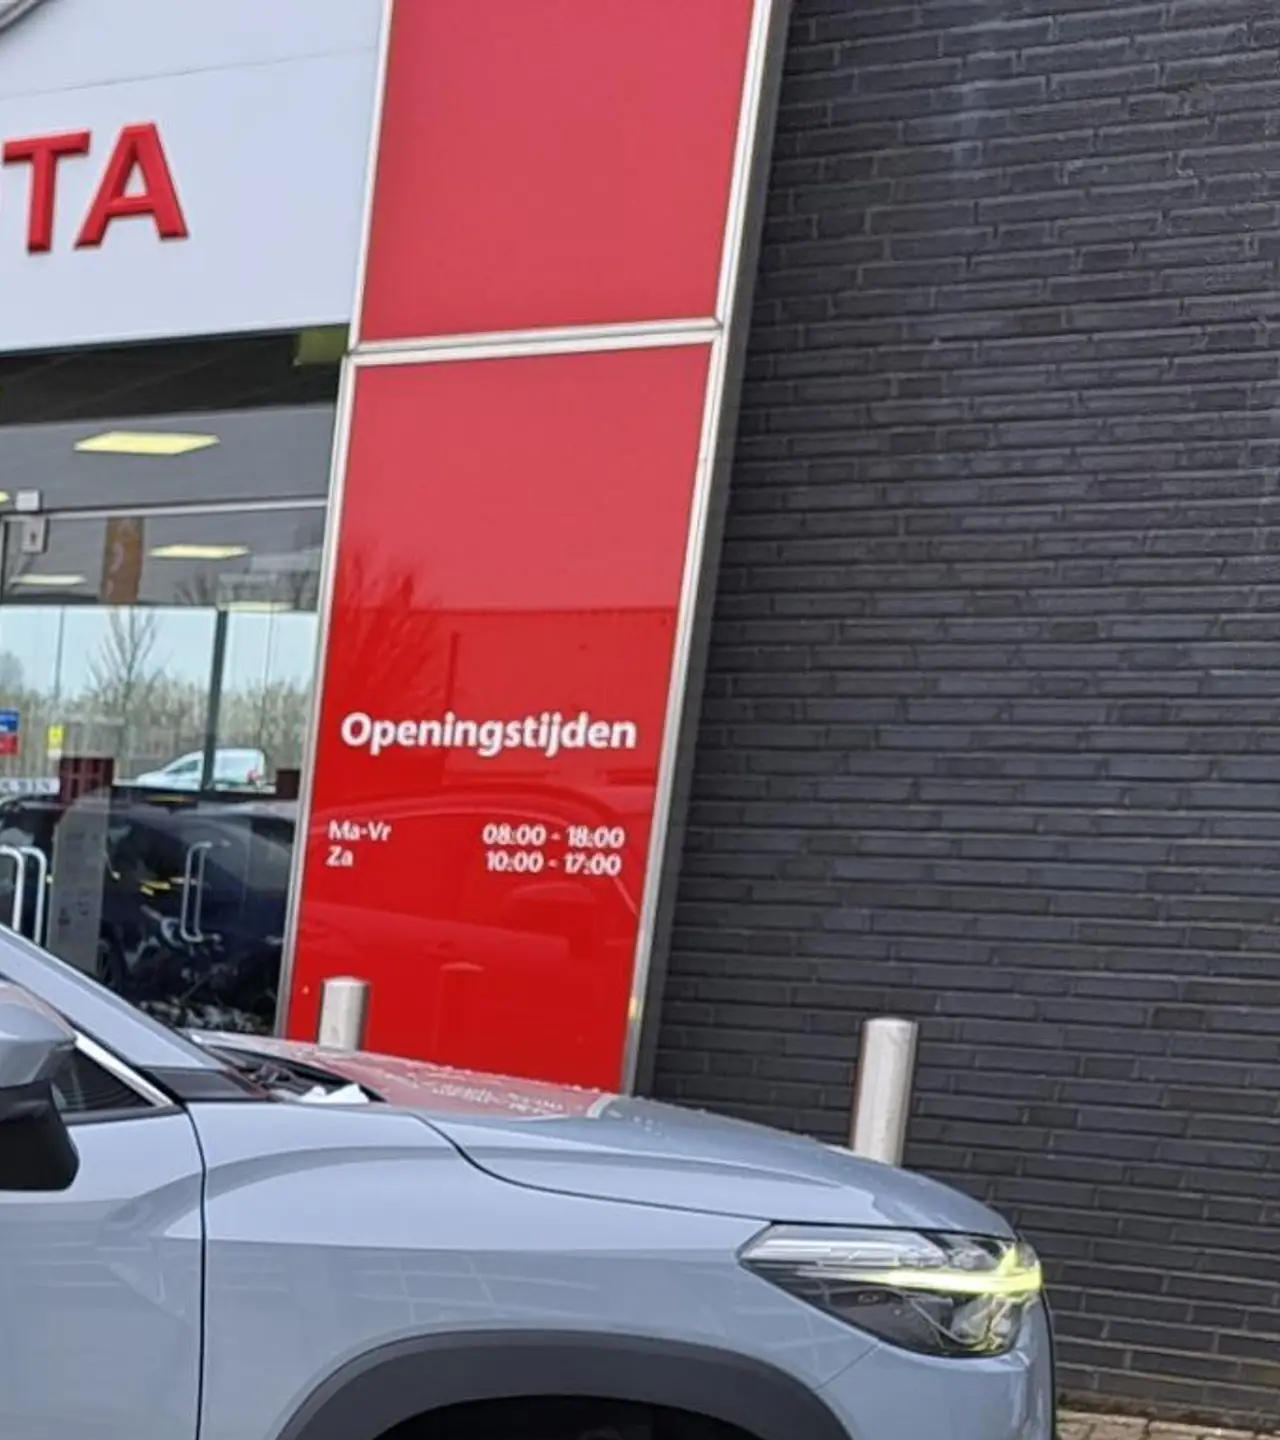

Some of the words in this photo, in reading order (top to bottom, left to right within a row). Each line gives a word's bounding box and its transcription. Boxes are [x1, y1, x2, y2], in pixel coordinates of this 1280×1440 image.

[340, 710, 637, 757] Openingstijden
[327, 819, 392, 842] Ma-Vr
[482, 823, 547, 846] 08:00
[566, 825, 626, 849] 18:00
[325, 845, 354, 867] Za
[485, 850, 544, 873] 10:00
[563, 852, 622, 877] 17:00
